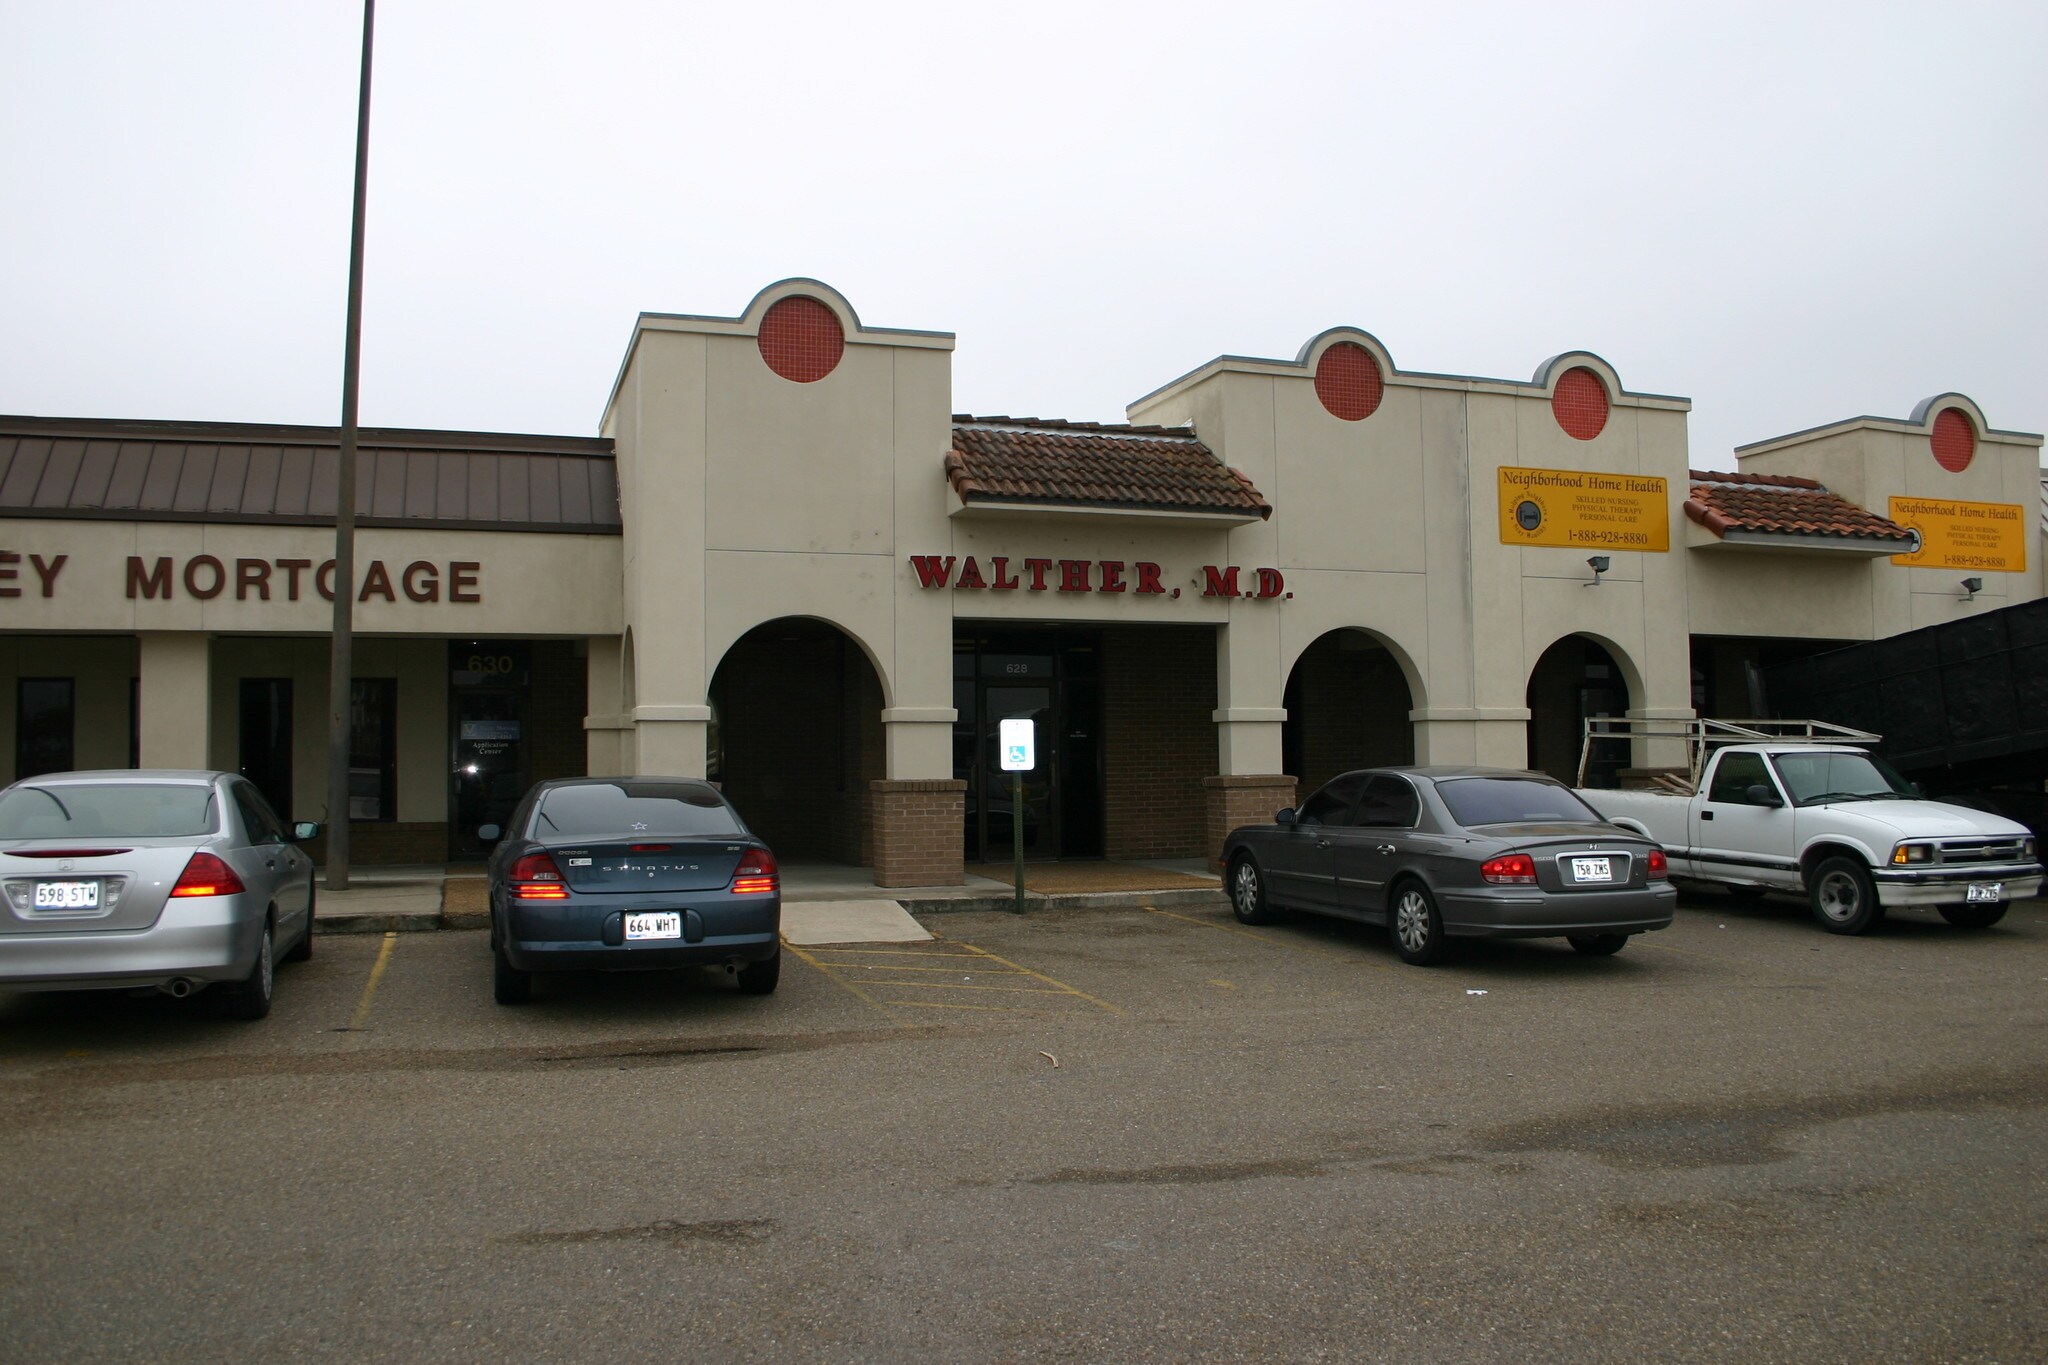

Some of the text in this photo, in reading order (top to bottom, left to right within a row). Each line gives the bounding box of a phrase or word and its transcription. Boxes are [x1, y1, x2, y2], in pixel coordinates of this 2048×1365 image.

[1503, 471, 1663, 493] Neighborhood Home Health
[1575, 495, 1639, 506] SKILLED NURSING
[1572, 504, 1643, 515] PHYSICAL THERAPY
[1895, 502, 2018, 520] Neighborhood Home Health
[1579, 513, 1638, 523] PERSONAL CARE
[1568, 529, 1648, 545] 1-888-928-8880
[1944, 554, 2006, 567] 1-888-928-8880
[910, 555, 1294, 599] WALTHER, M.D.
[467, 655, 513, 674] 630
[1006, 663, 1029, 674] 628
[39, 886, 97, 903] 598 STW
[629, 918, 677, 932] 664 WHT
